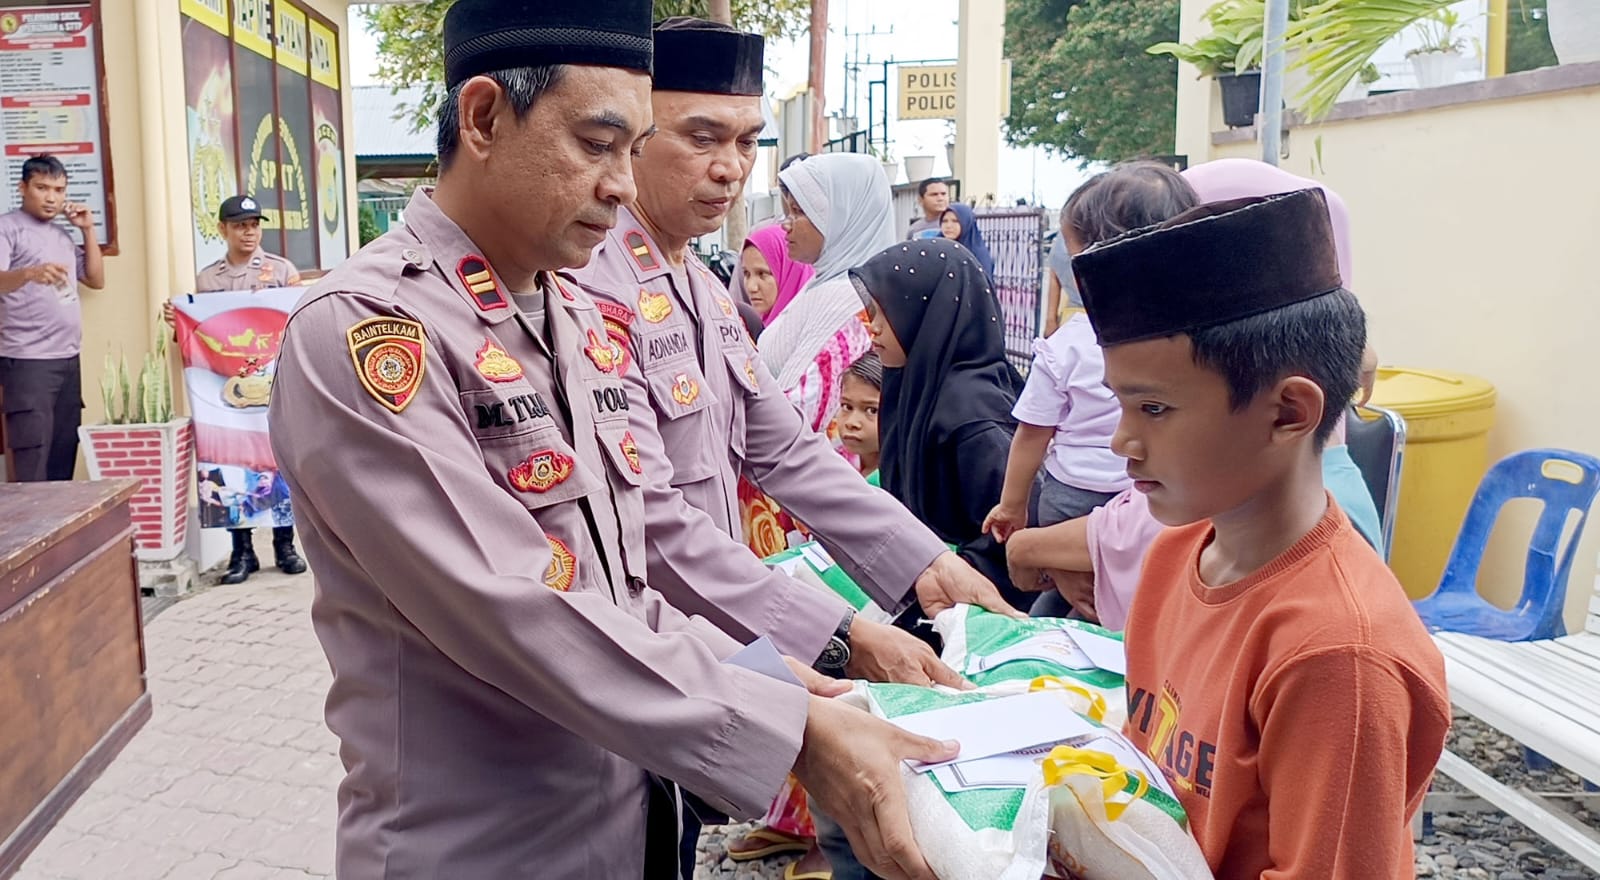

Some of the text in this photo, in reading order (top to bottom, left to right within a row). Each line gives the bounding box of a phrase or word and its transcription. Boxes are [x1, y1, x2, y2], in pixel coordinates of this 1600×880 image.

[906, 95, 956, 111] POLIC
[352, 323, 417, 342] BAINTELKAM
[719, 324, 743, 343] PO
